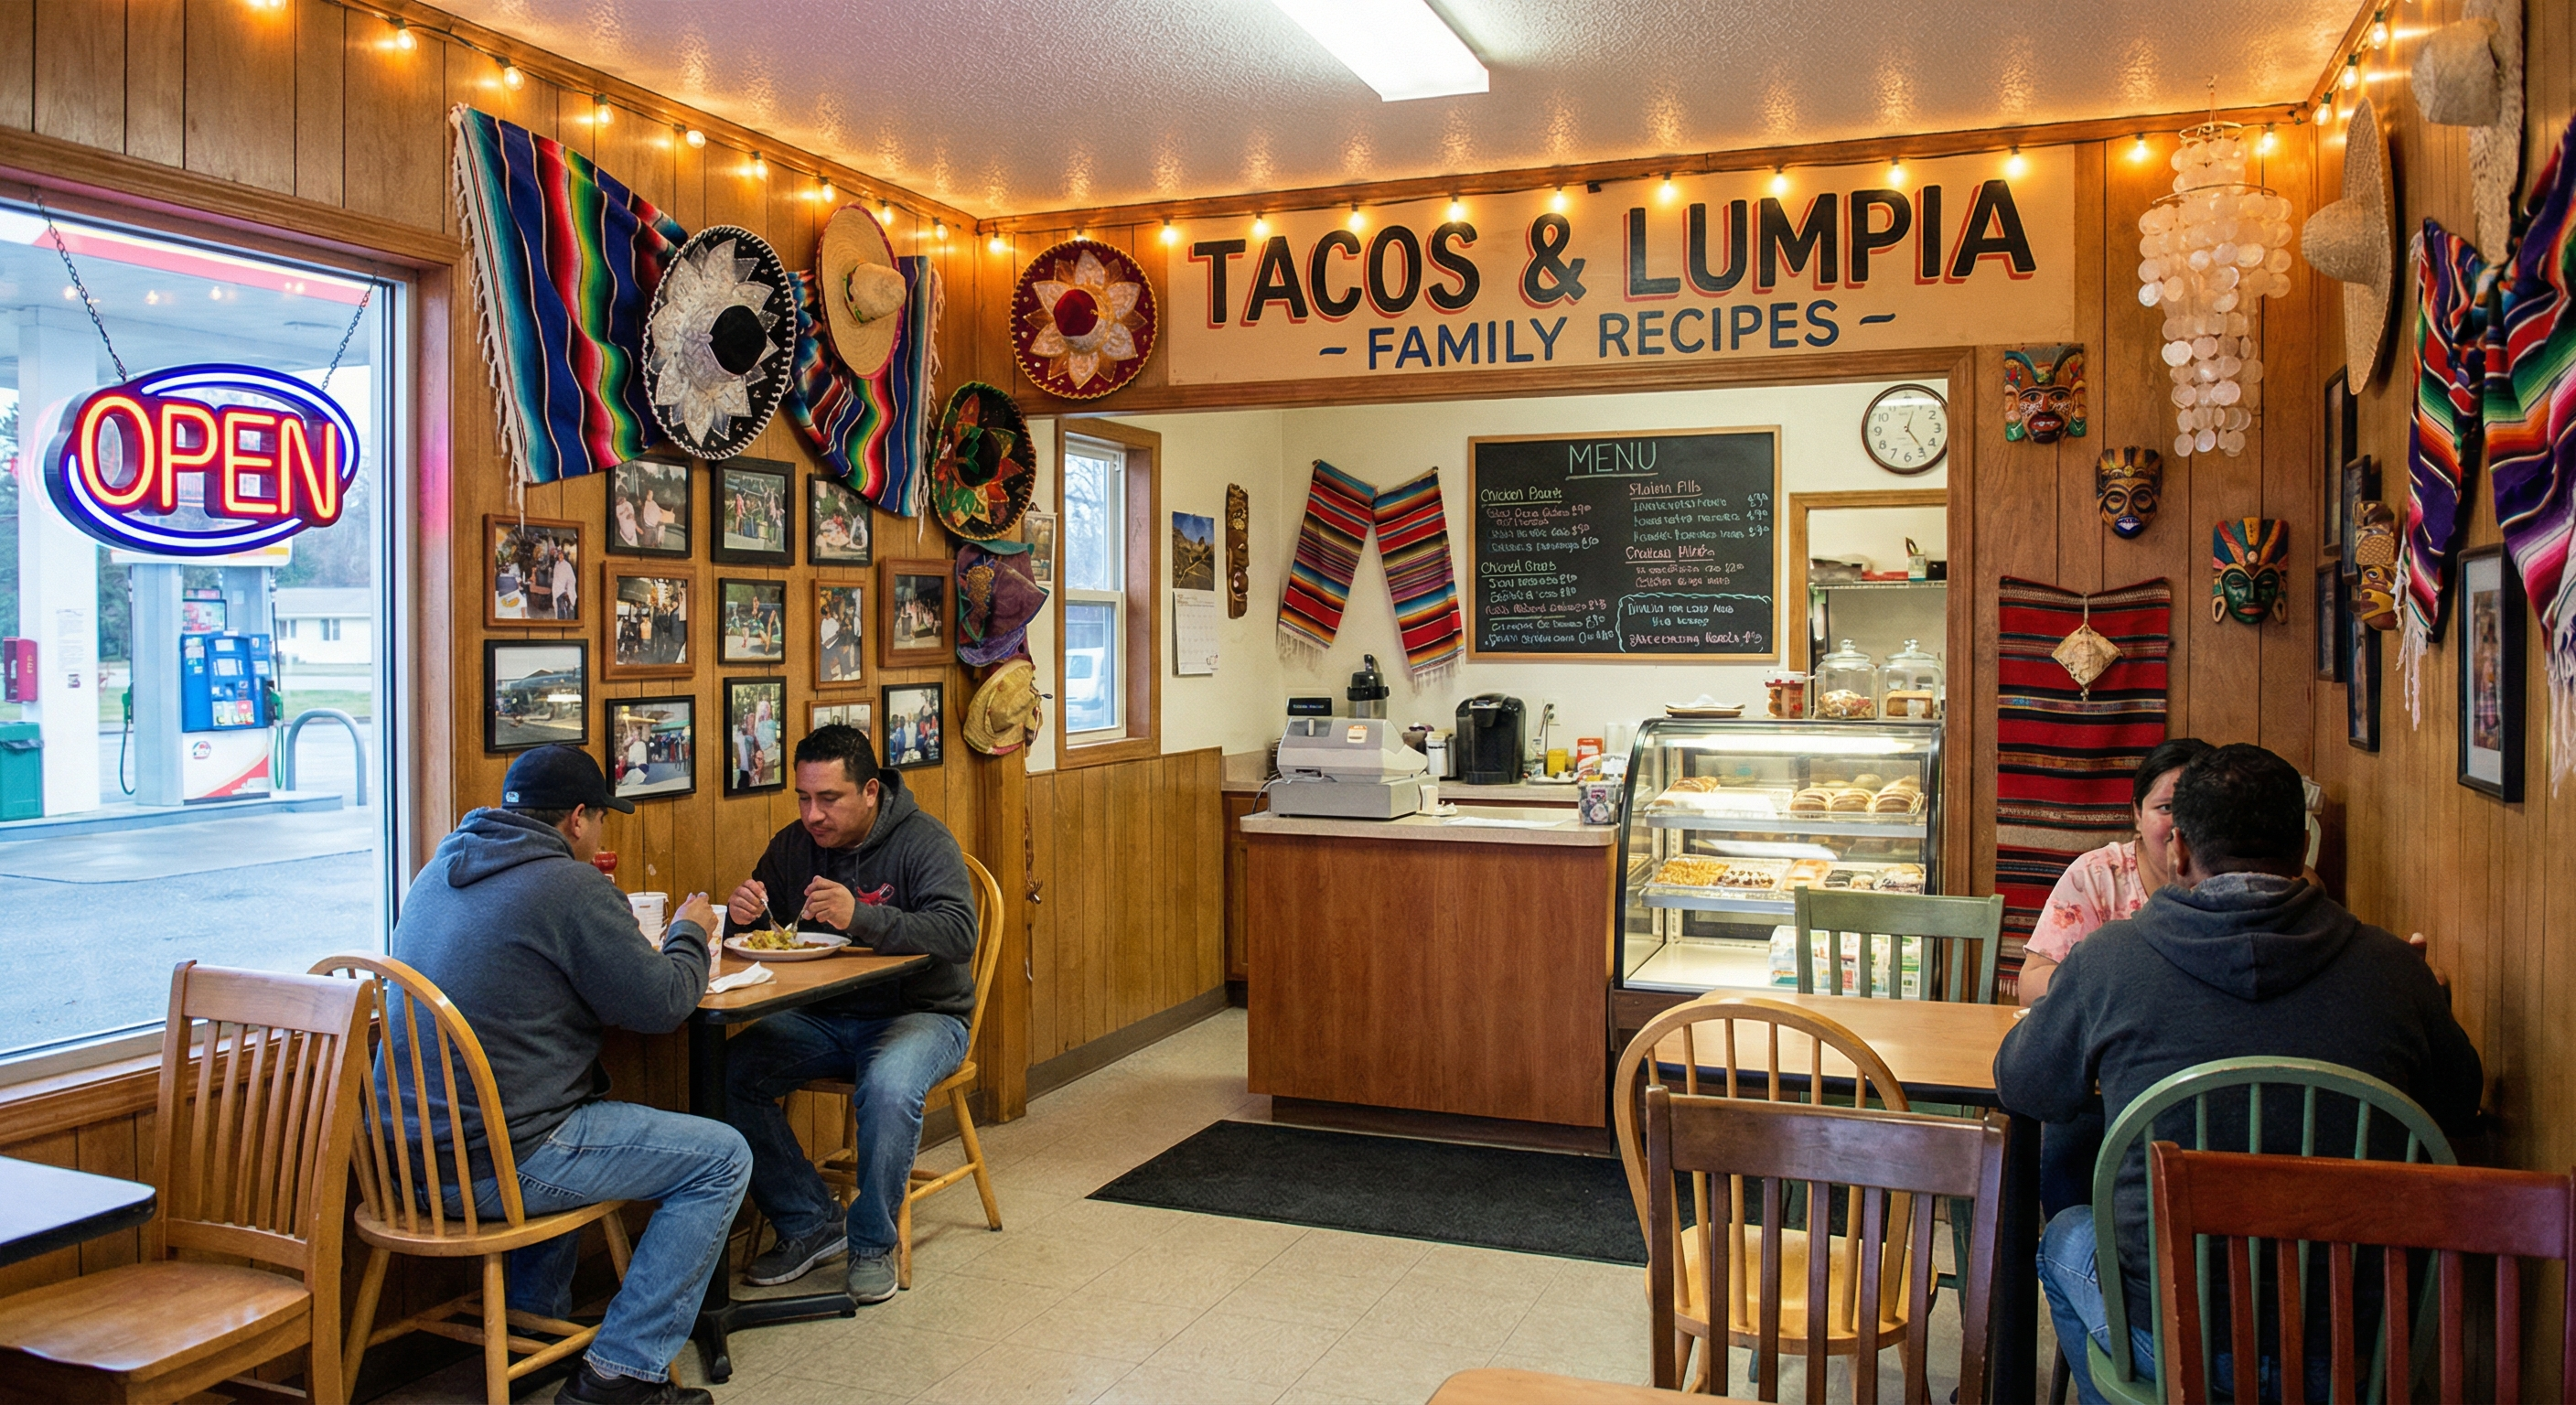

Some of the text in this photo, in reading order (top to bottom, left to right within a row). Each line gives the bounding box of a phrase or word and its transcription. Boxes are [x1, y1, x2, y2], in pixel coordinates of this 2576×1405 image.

[1188, 179, 2036, 328] TACOS & LUMPIA
[1368, 298, 1841, 371] FAMILY RECIPES
[1878, 413, 1889, 422] 10
[1928, 410, 1937, 420] 2
[1873, 426, 1883, 436] 9
[1934, 423, 1942, 434] 3
[1878, 440, 1887, 450] 8
[1927, 437, 1937, 447] 4
[78, 393, 338, 522] OPEN
[1568, 441, 1658, 475] MENU
[1891, 448, 1898, 459] 7
[1904, 452, 1912, 463] 6
